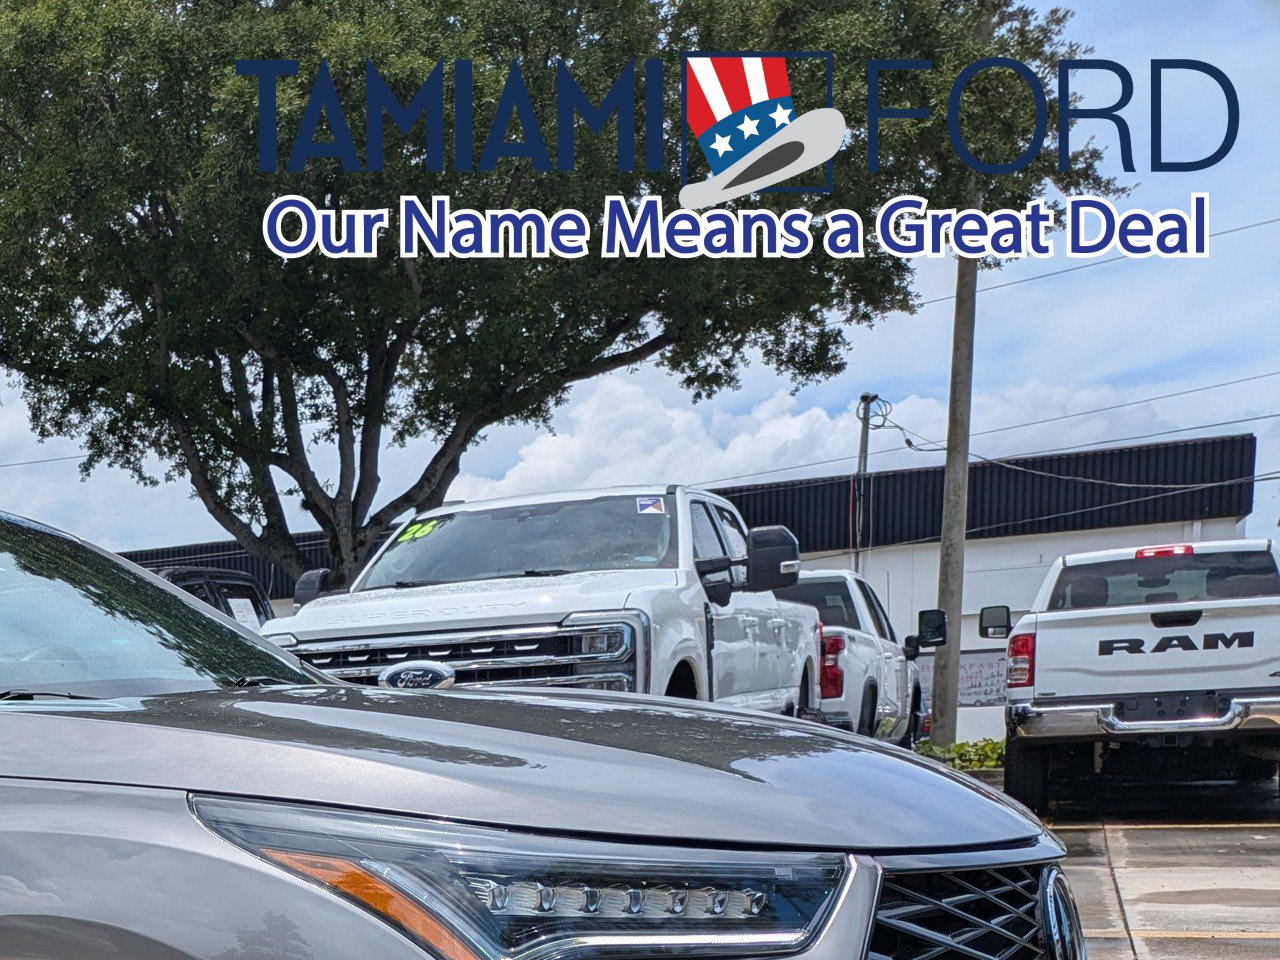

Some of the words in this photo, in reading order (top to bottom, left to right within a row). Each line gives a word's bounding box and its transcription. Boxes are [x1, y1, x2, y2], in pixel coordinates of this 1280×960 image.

[398, 519, 438, 543] 26
[1098, 631, 1254, 656] RAM
[396, 670, 432, 688] Ford
